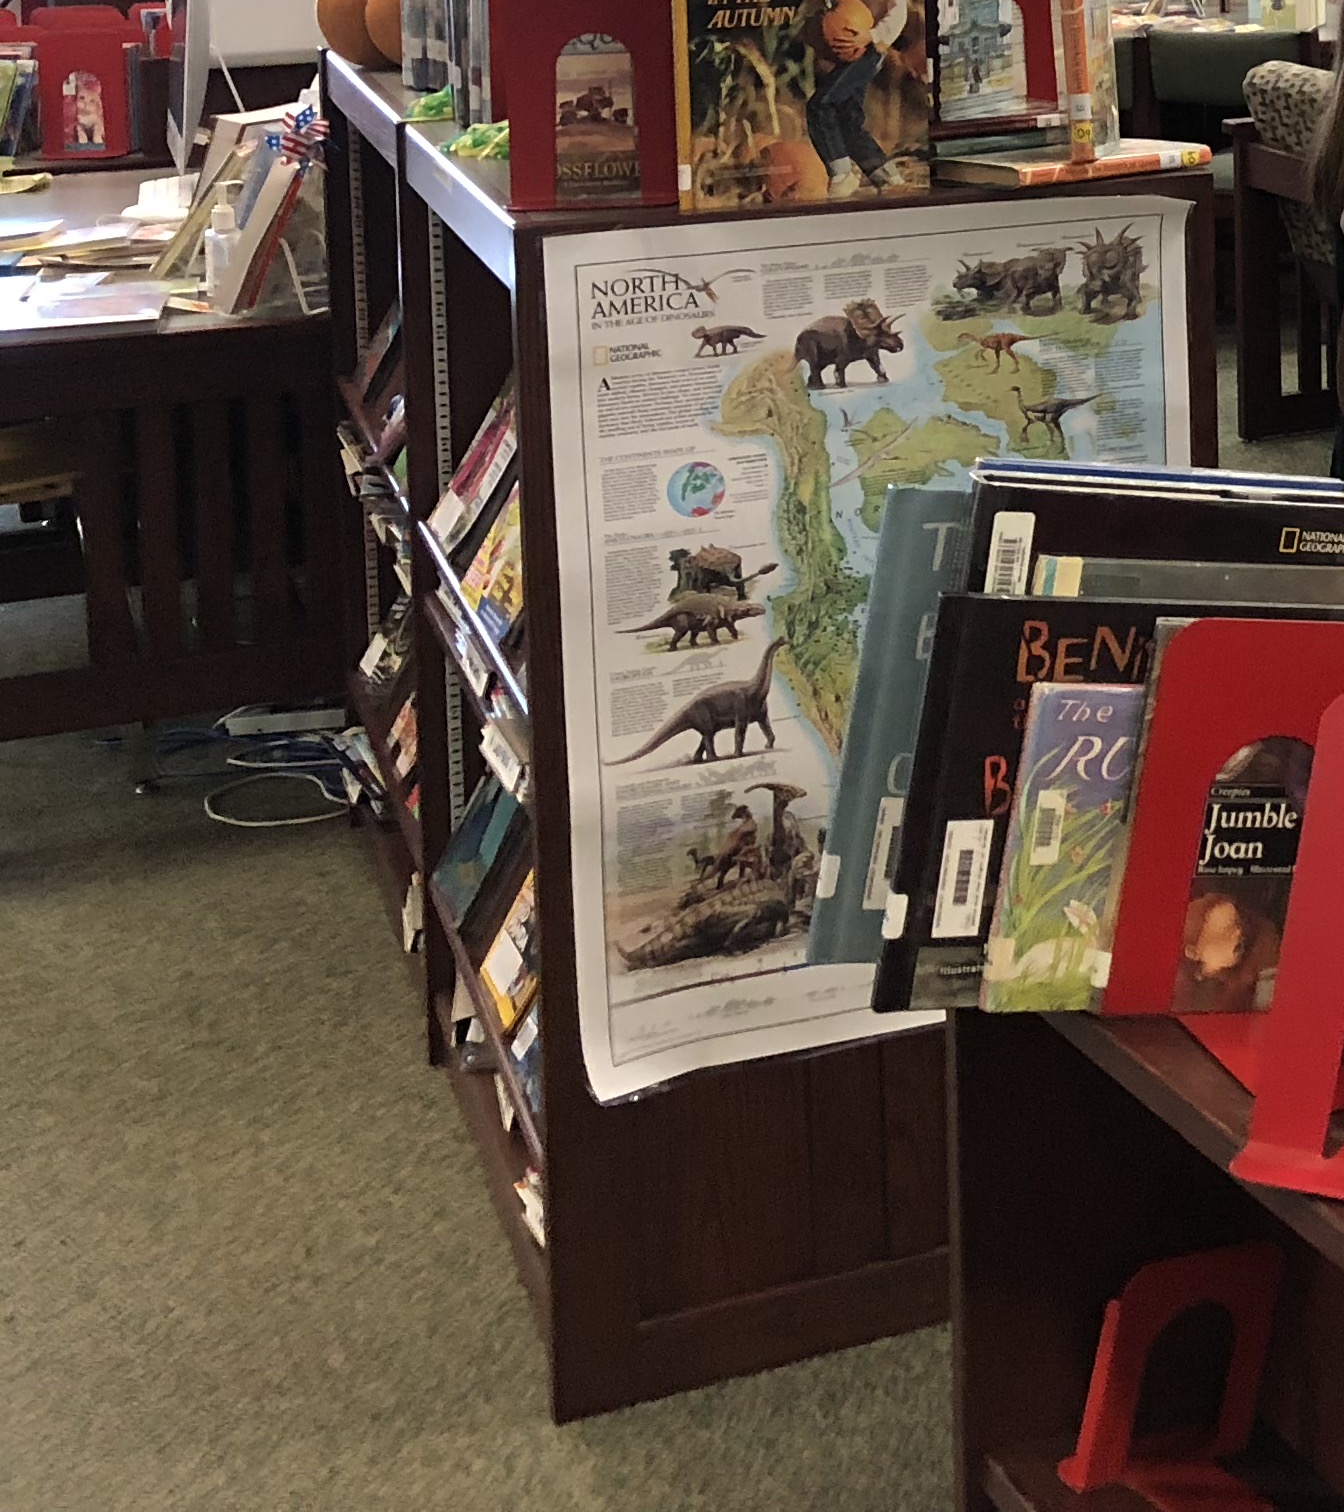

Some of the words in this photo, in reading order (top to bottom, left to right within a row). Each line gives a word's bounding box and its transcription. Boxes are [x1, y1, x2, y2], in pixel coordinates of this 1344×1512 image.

[706, 5, 796, 29] AUTUMN
[591, 274, 681, 300] NORTH
[591, 292, 700, 319] AMERICA
[609, 342, 650, 353] NATIONAL
[610, 349, 662, 363] GEOGRAPHIC
[1057, 699, 1114, 724] The
[1204, 802, 1298, 835] Jumble
[1198, 834, 1263, 866] Joan
